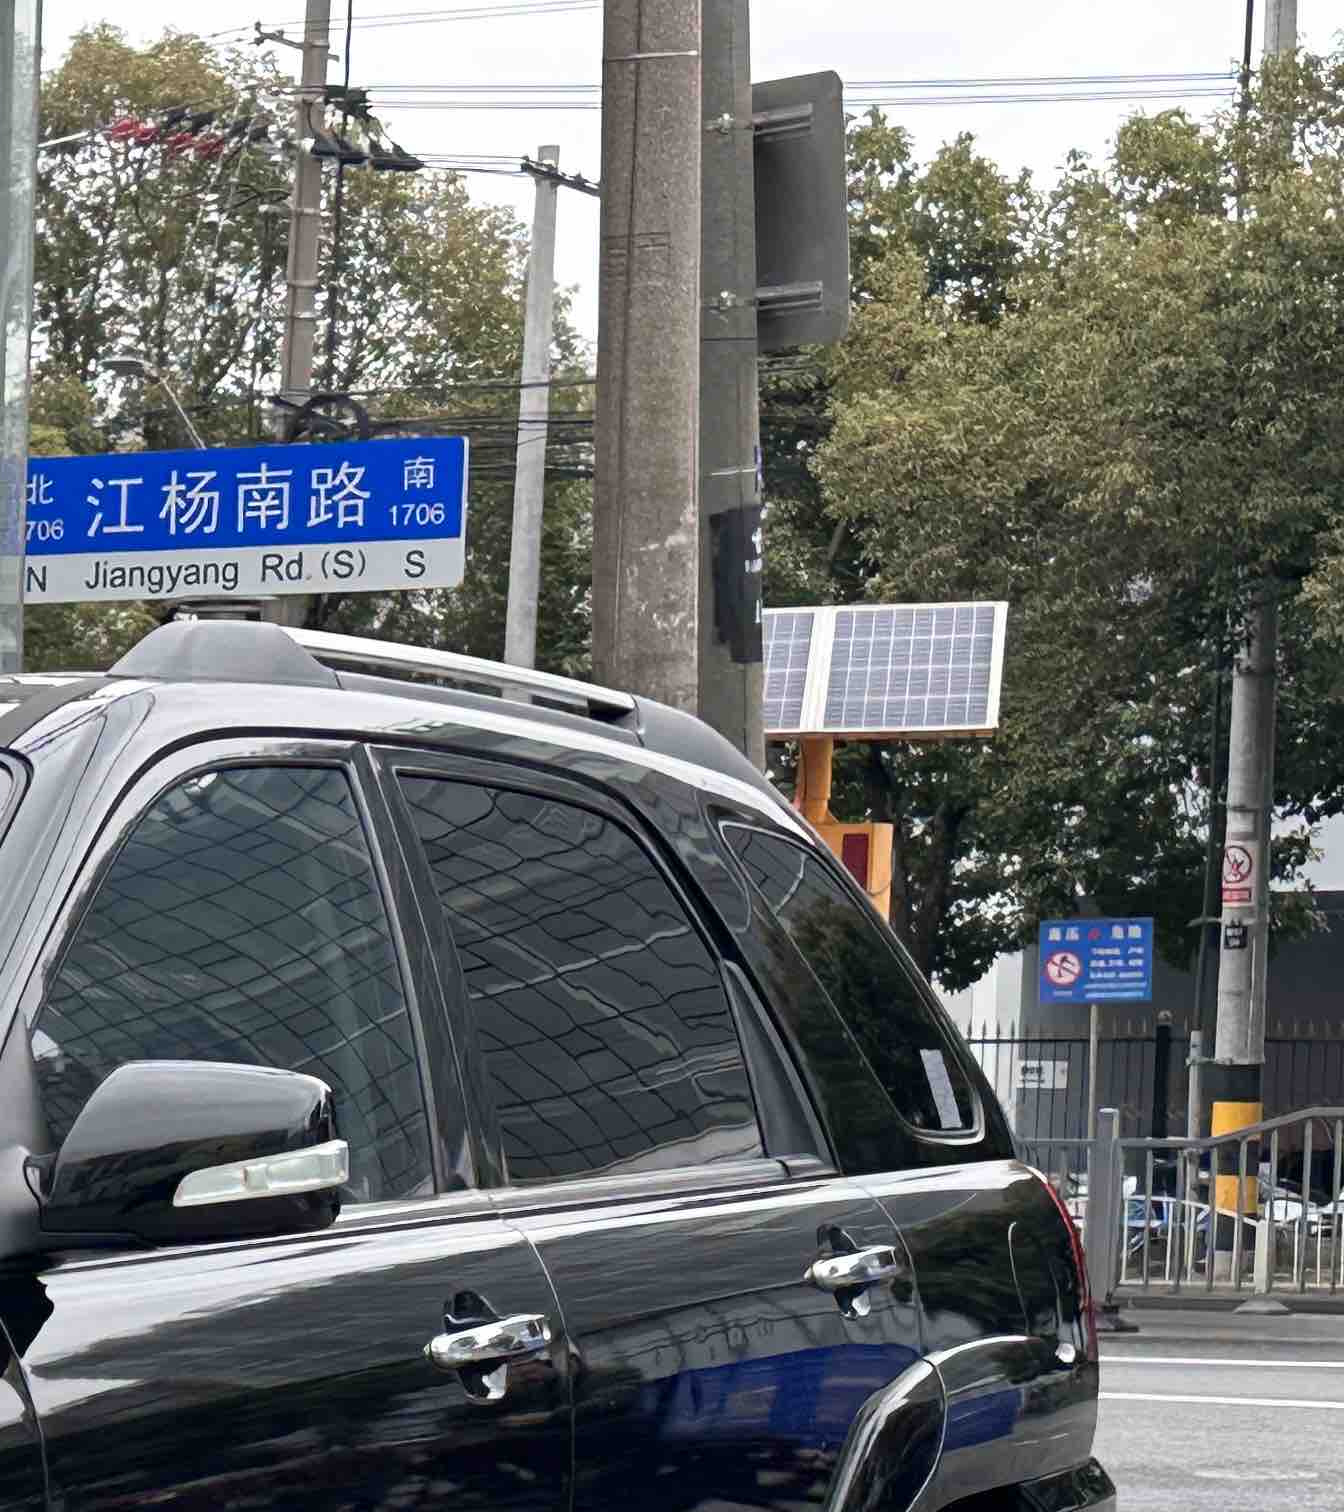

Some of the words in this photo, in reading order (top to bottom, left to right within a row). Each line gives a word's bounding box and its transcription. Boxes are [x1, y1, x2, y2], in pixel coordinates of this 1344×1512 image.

[25, 473, 53, 505] 北
[87, 461, 371, 537] 江杨南路
[404, 456, 435, 491] 南
[25, 519, 64, 541] 706
[390, 503, 445, 527] 1706
[26, 565, 47, 592] N
[85, 561, 239, 593] Jiangyang
[404, 550, 426, 578] S
